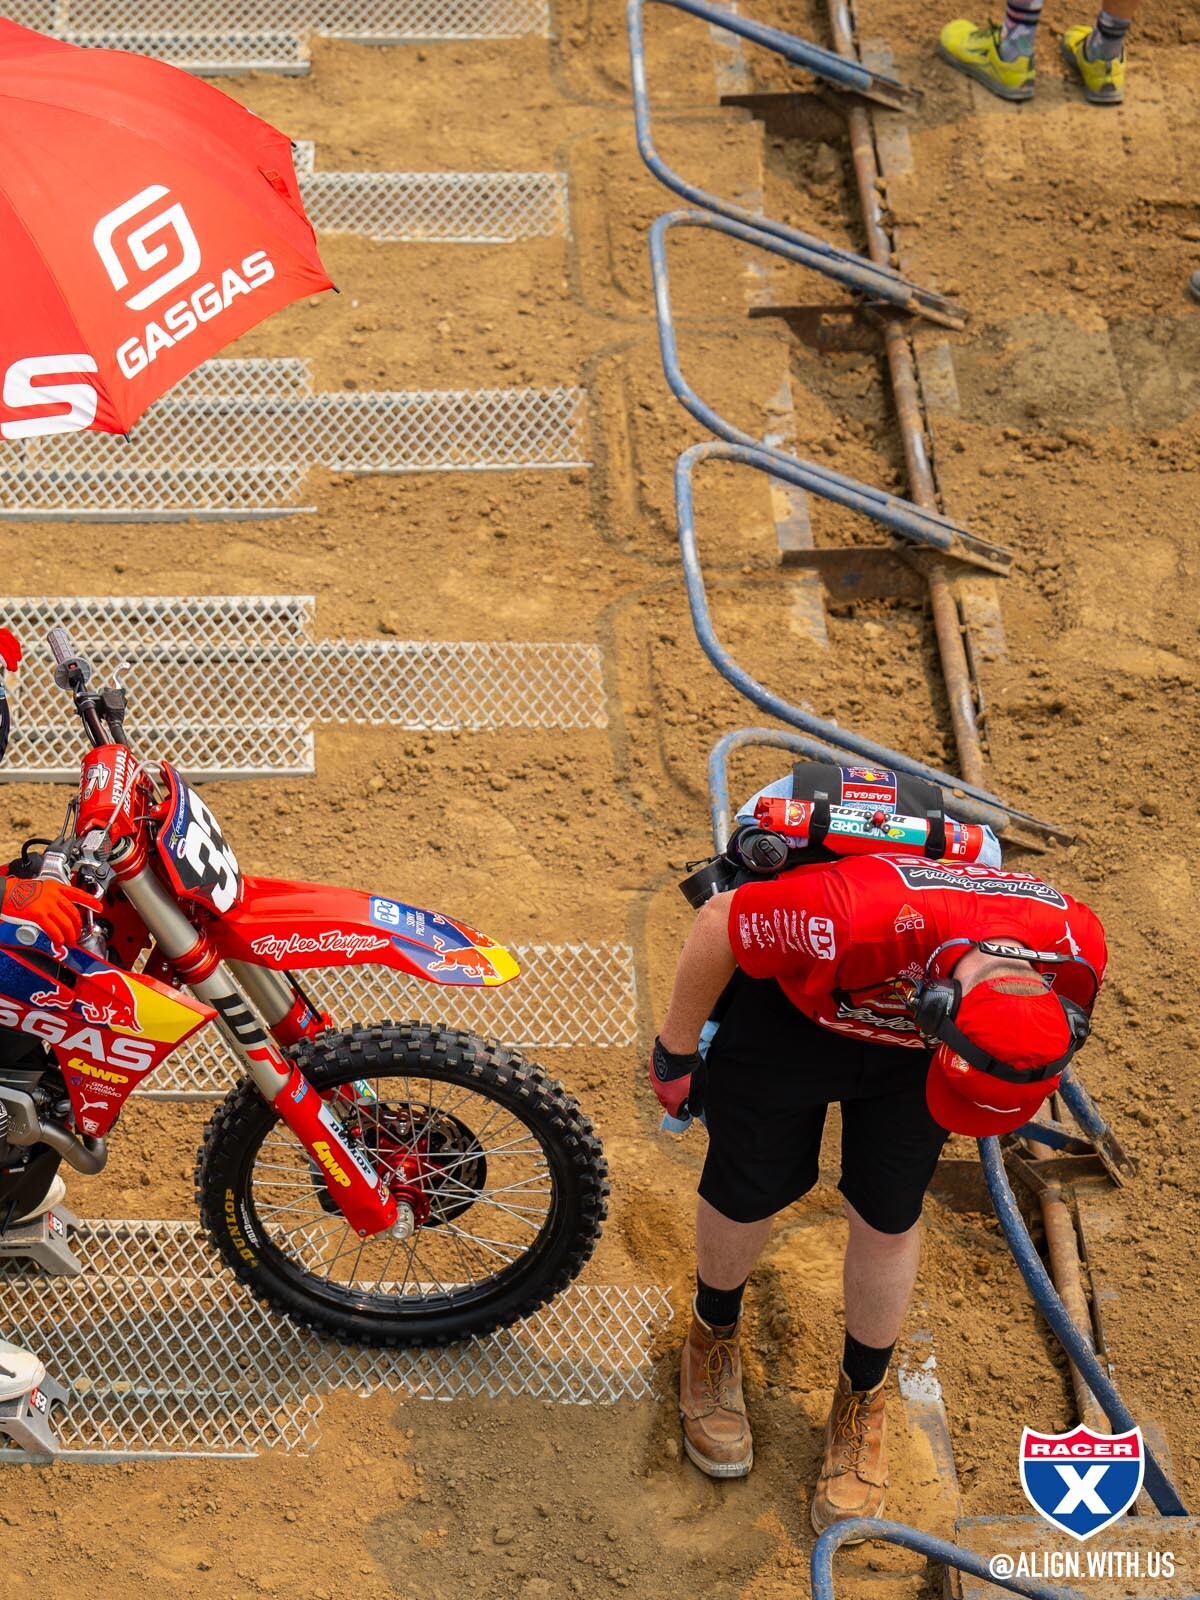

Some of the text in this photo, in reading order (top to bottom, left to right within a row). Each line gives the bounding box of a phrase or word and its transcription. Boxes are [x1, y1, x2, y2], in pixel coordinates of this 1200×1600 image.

[116, 250, 275, 379] GASGAS
[112, 750, 128, 805] RENTHAL
[844, 790, 893, 801] GASGAS
[185, 788, 241, 914] 33
[910, 868, 1058, 900] Troy Lee Designs
[406, 911, 417, 928] SONY
[751, 912, 764, 949] SENA
[252, 930, 390, 960] Troy Lee Designs
[985, 942, 1058, 960] SENA
[209, 992, 291, 1076] WP
[85, 1082, 122, 1098] TURISMO
[91, 1080, 116, 1093] GRAN
[225, 1188, 254, 1259] DUNLOP
[35, 1391, 47, 1413] 33
